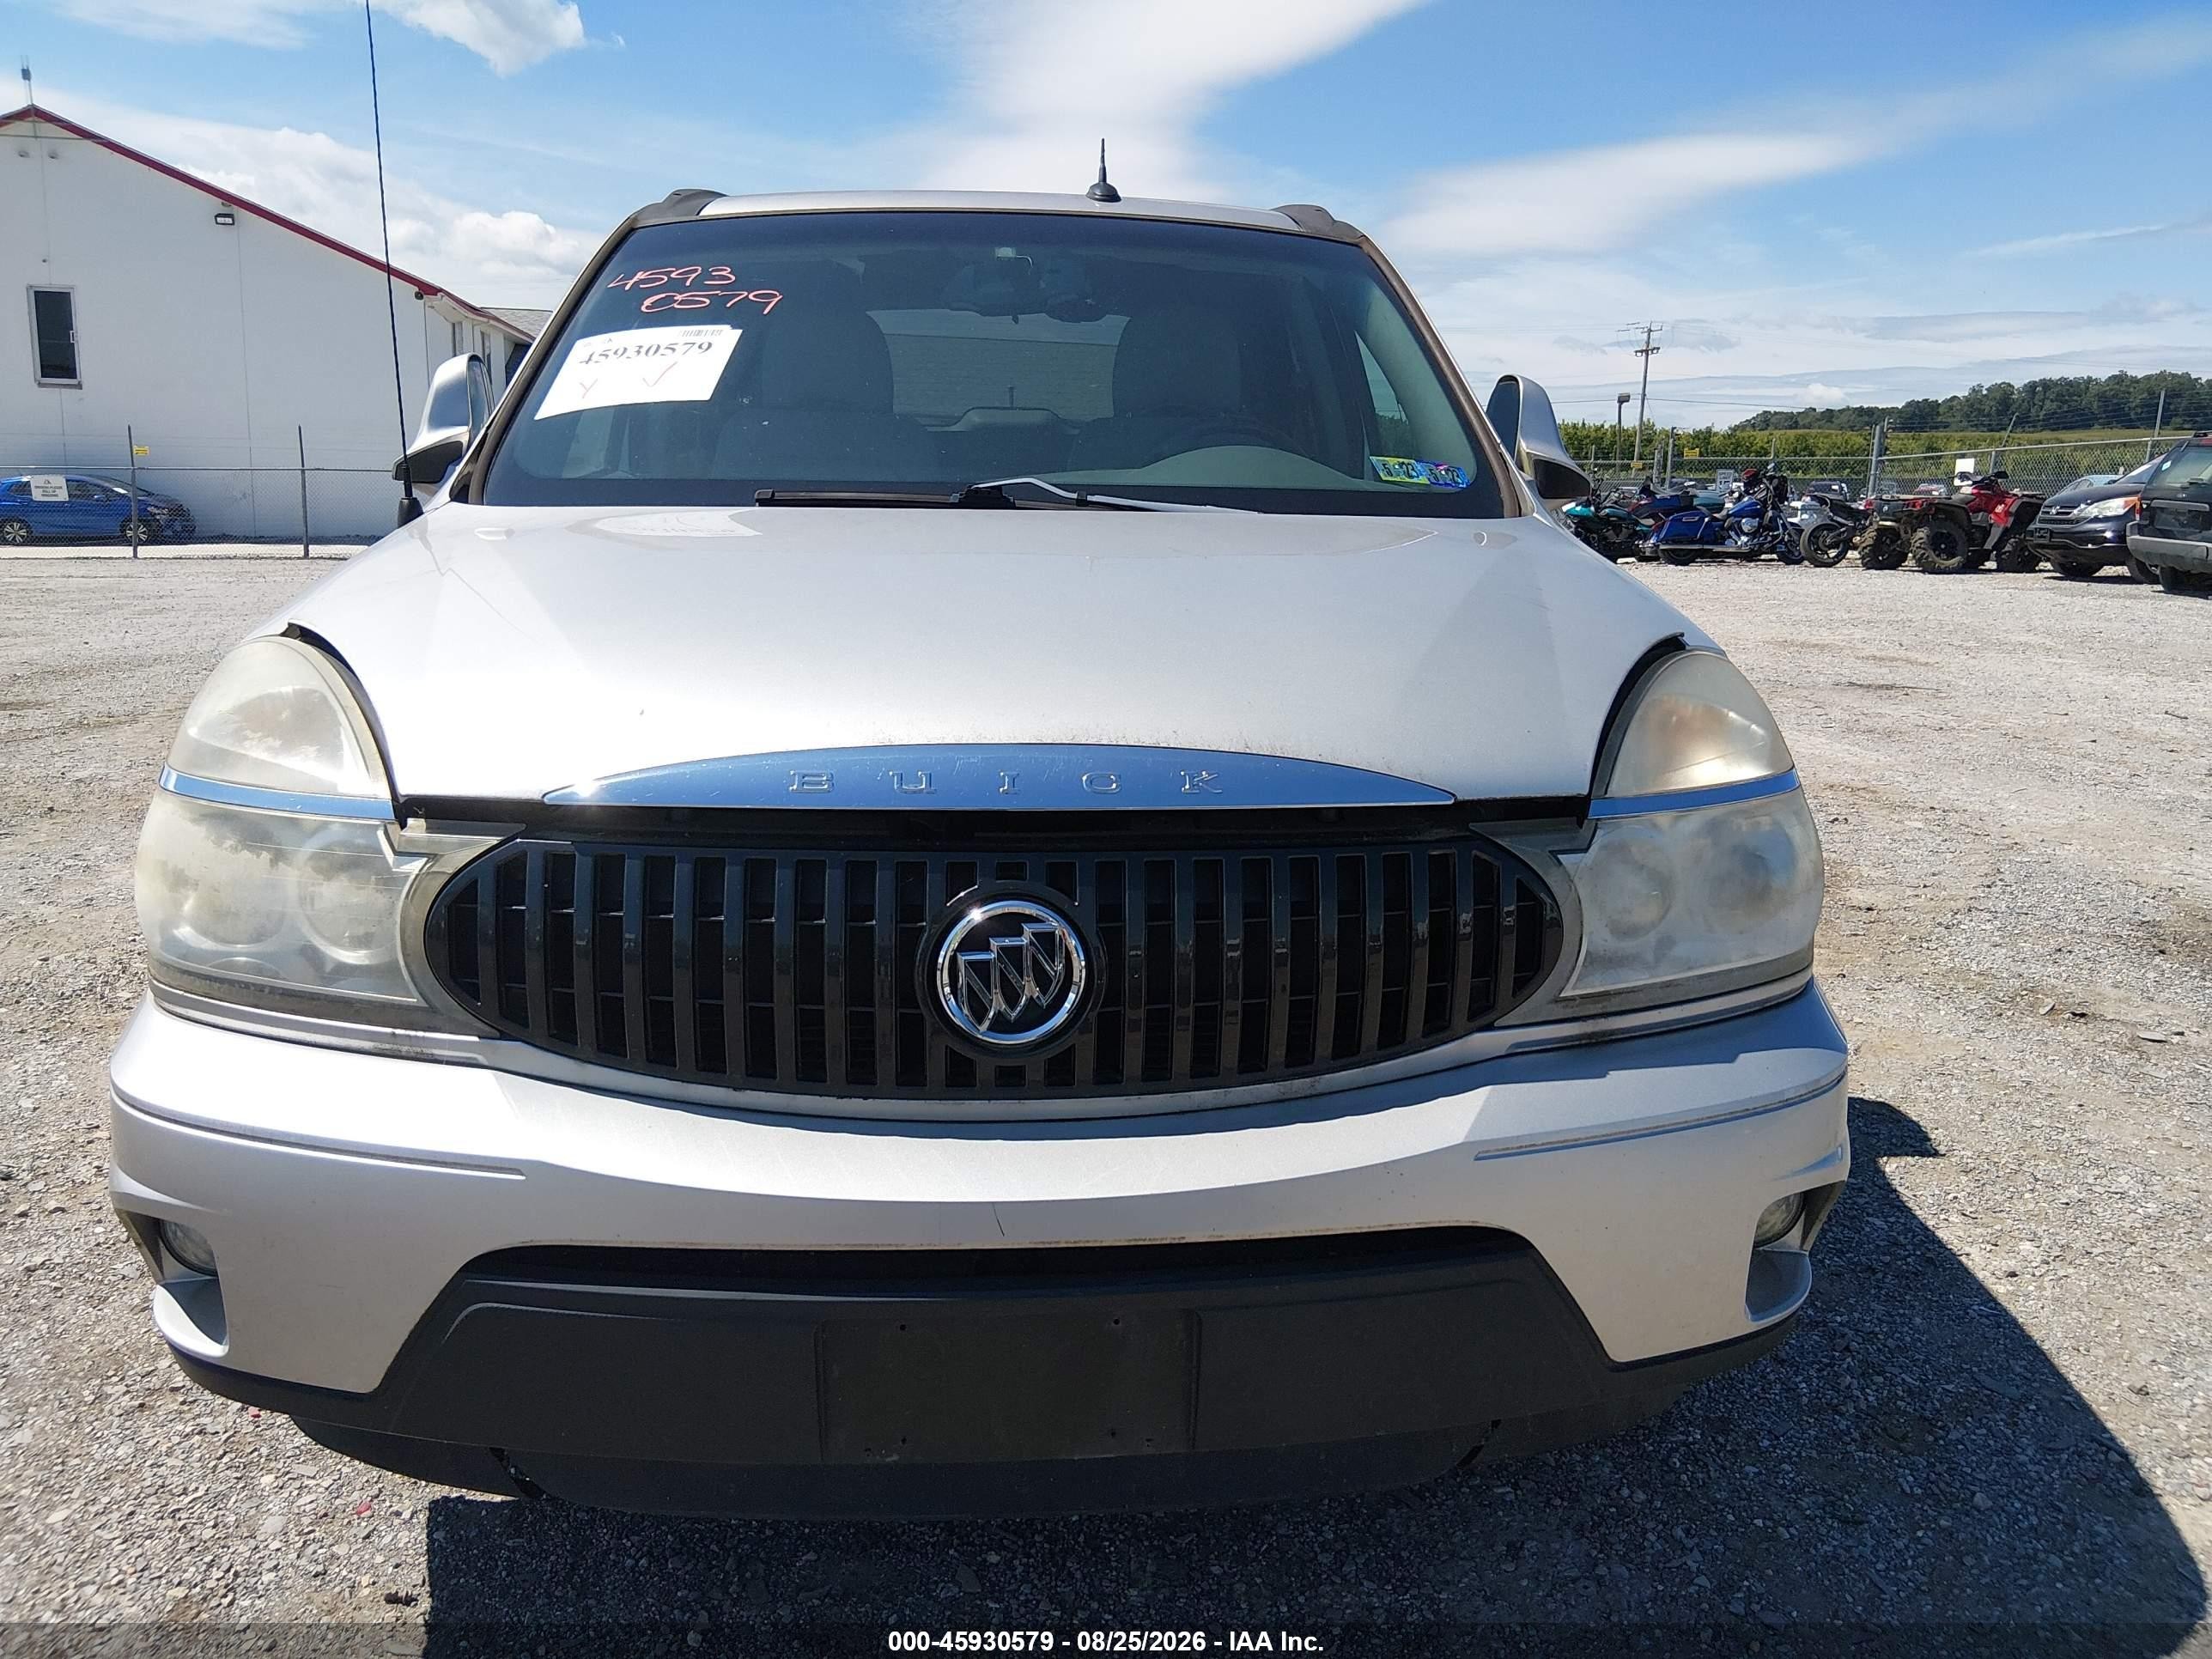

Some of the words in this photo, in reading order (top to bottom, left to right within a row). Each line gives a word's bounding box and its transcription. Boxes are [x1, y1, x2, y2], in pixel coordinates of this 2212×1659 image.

[607, 265, 736, 290] 4593
[641, 290, 783, 315] 0579
[579, 341, 713, 365] 45930579
[1381, 462, 1394, 477] 5
[789, 769, 1223, 795] BUICK
